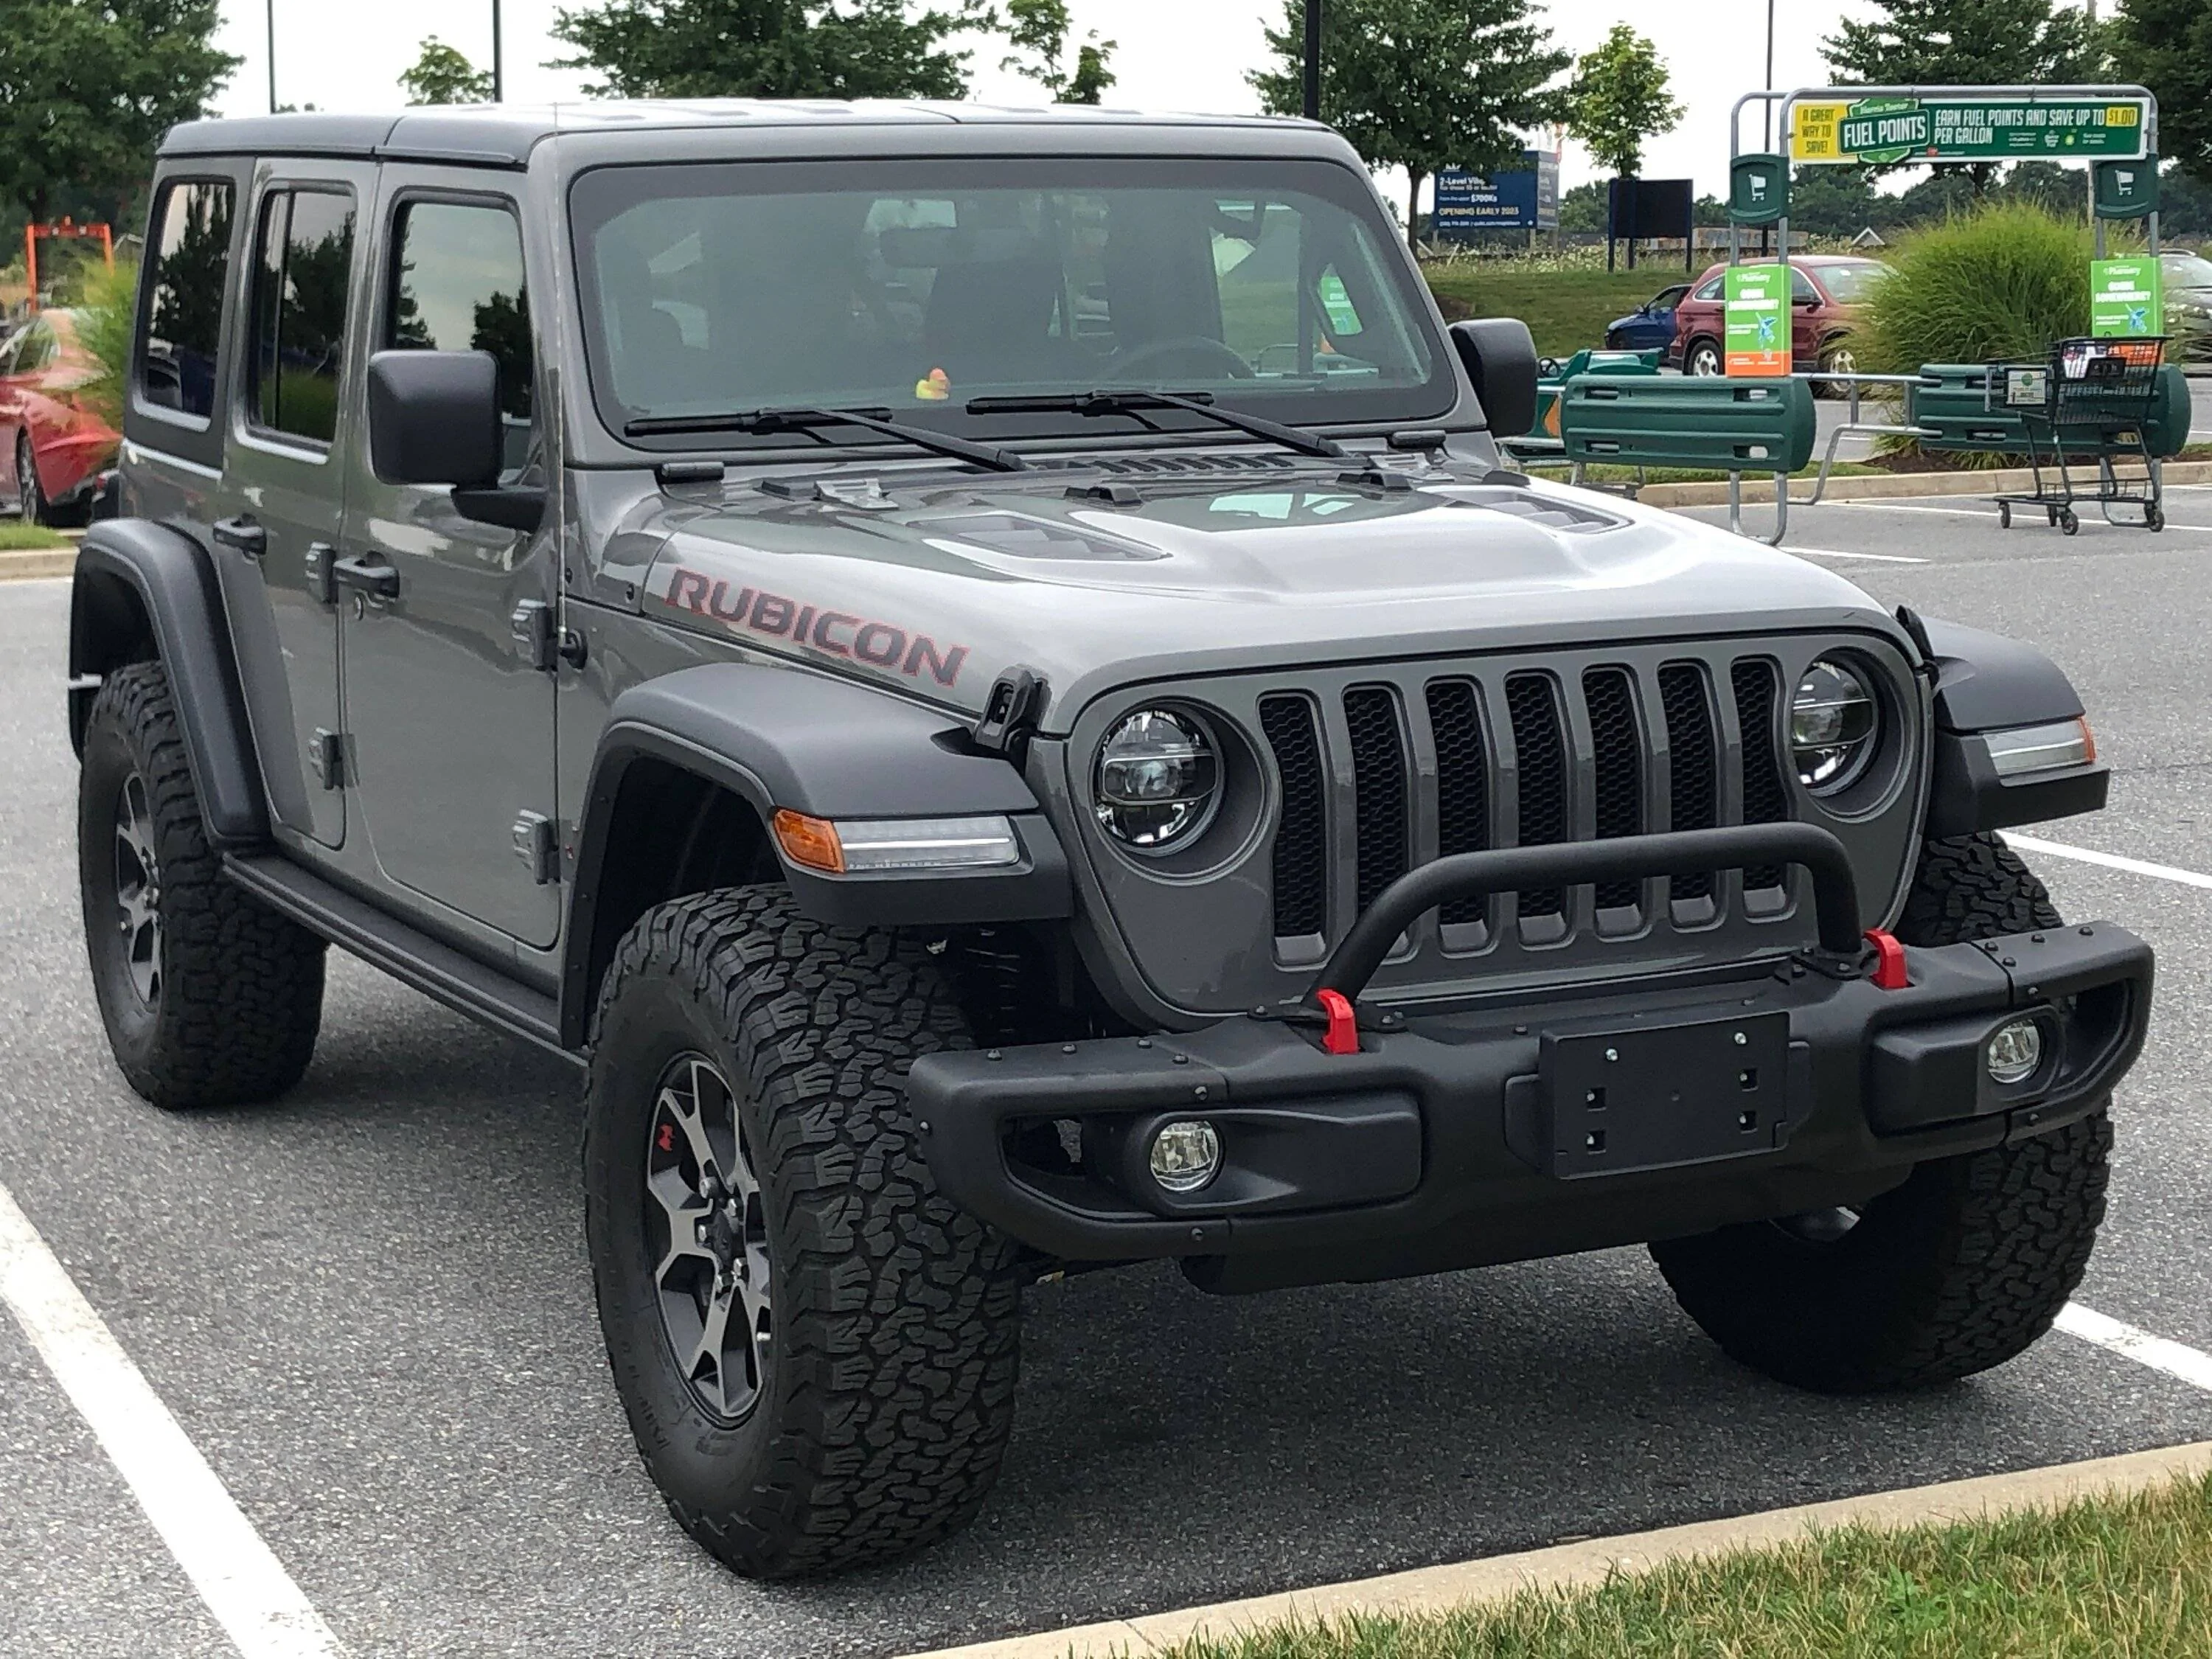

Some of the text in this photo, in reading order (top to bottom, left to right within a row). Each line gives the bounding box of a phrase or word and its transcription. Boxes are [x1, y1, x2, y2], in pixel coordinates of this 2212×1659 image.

[1802, 108, 1834, 122] A GREAT
[1935, 109, 2136, 126] EARN FUEL POINTS AND SAVE UP TO $1.00
[1801, 124, 1832, 138] WAY TO
[1844, 116, 1927, 147] FUEL POINTS
[1934, 127, 1953, 144] PER
[1955, 127, 1994, 144] GALLON
[1806, 140, 1828, 153] SAVE!
[1439, 176, 1467, 185] 2-Level
[1439, 207, 1475, 216] OPENING
[1475, 207, 1500, 216] EARLY
[664, 568, 970, 688] RUBICON
